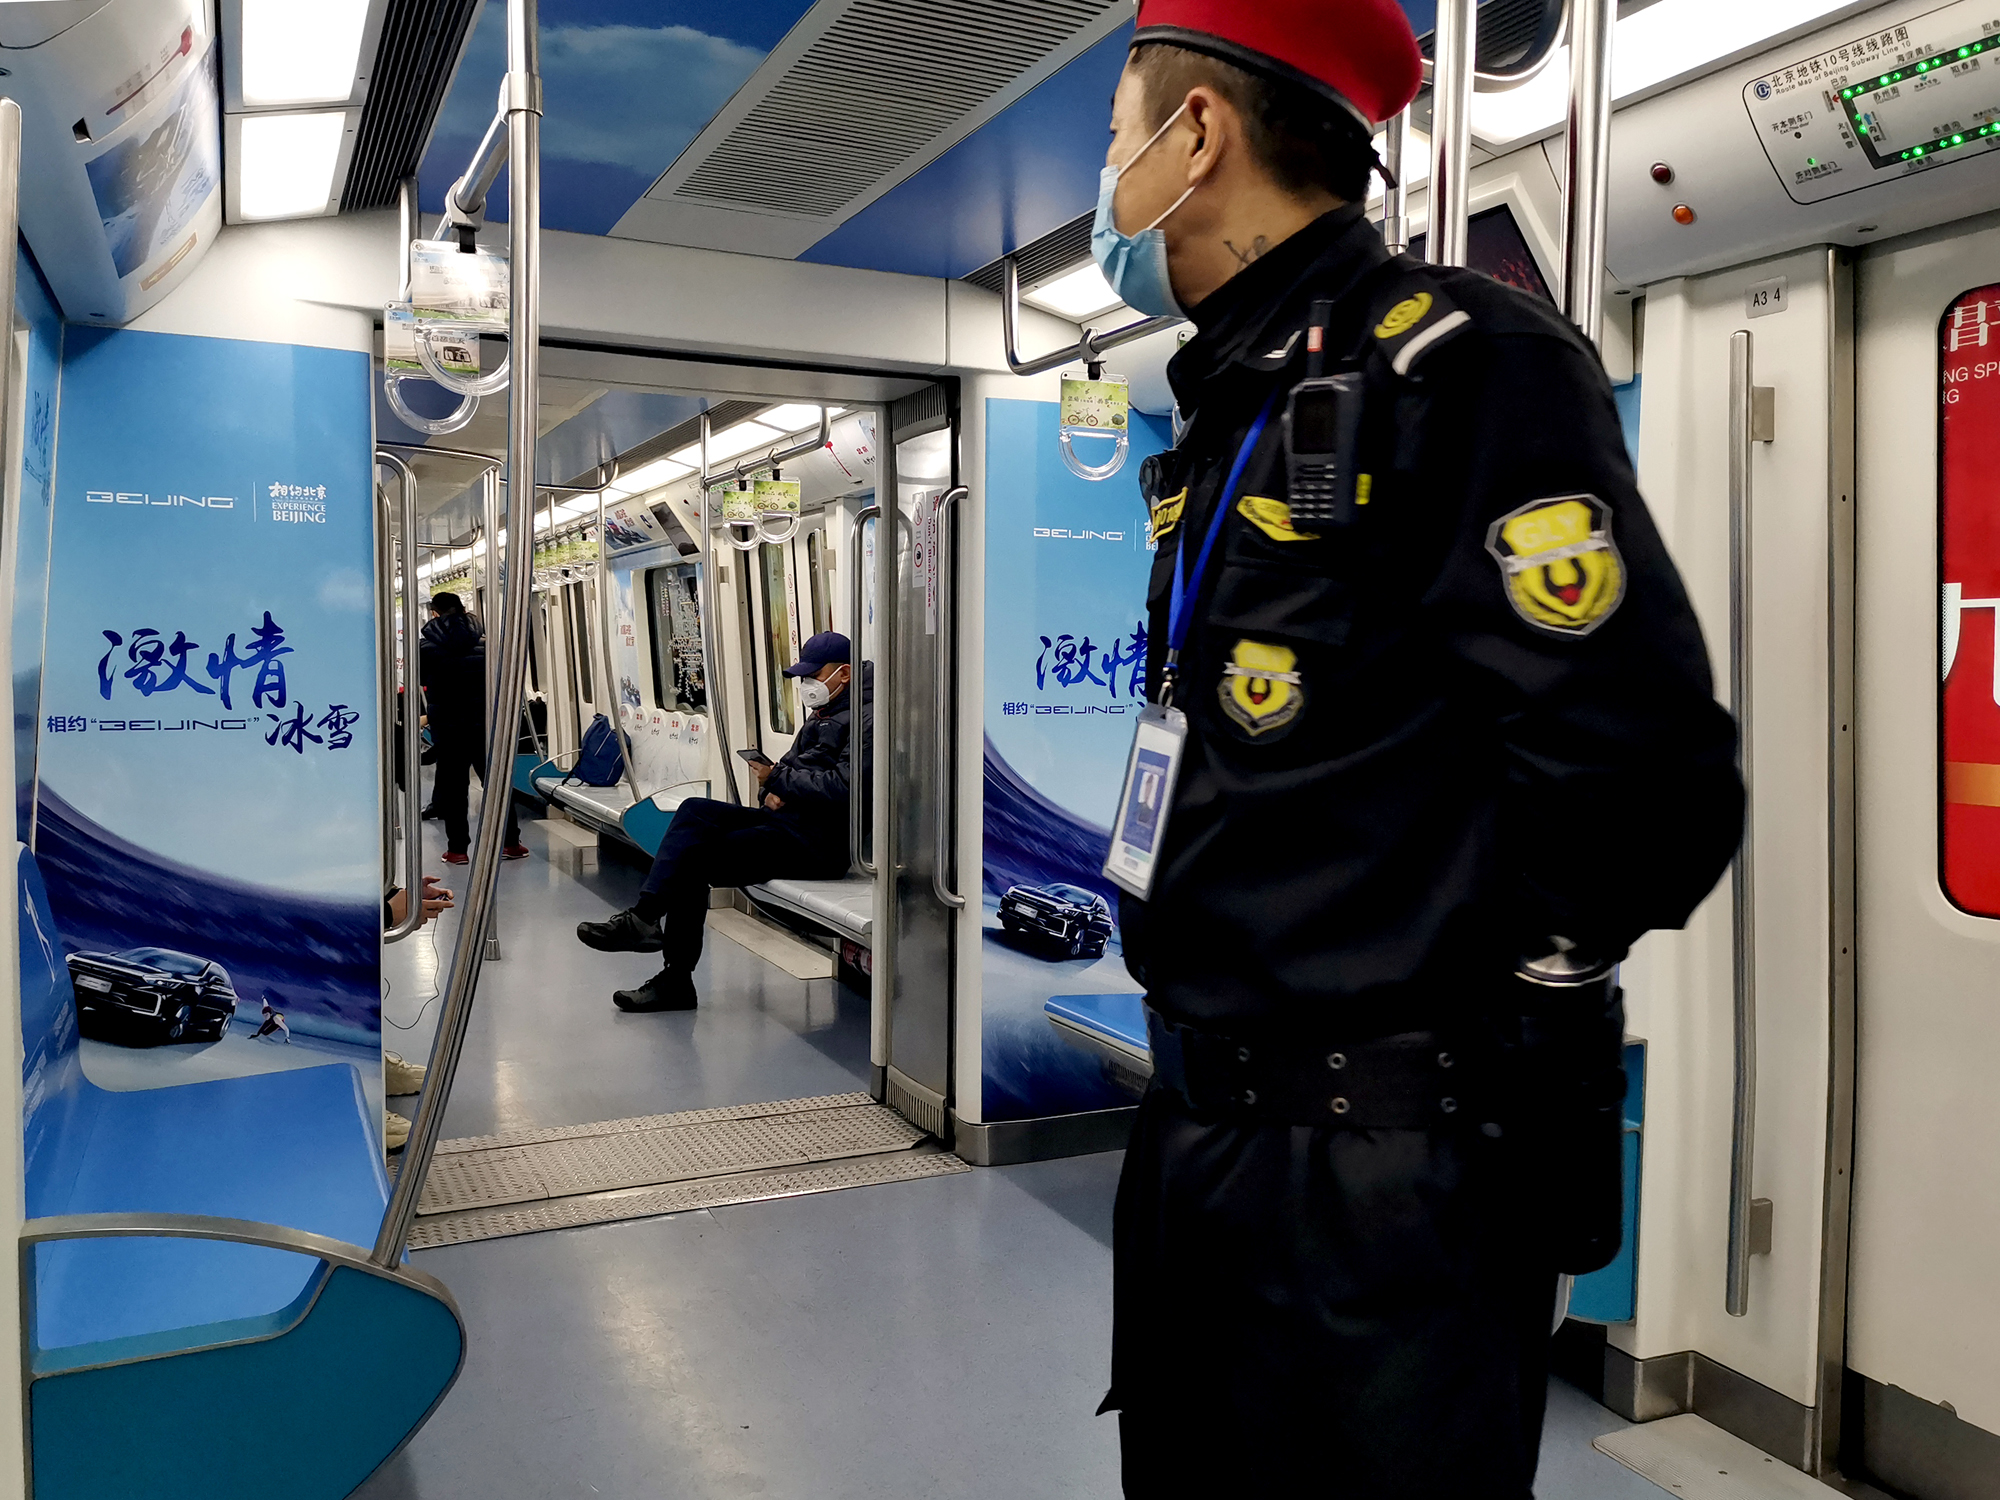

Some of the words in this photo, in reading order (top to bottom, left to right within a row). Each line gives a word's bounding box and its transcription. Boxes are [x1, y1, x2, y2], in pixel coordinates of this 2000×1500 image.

[1771, 26, 1909, 88] 北京地铁10号线线路图
[1775, 83, 1796, 96] Route
[1799, 77, 1813, 89] Map
[1815, 73, 1822, 82] of
[1823, 64, 1850, 79] Beijing
[1851, 53, 1880, 68] Subway
[1882, 44, 1899, 56] Line
[1902, 40, 1911, 49] 10
[1753, 291, 1767, 307] A3
[1774, 287, 1781, 302] 4
[86, 490, 235, 509] BEIJING
[268, 481, 327, 500] 相约北京
[271, 501, 327, 513] EXPERIENCE
[272, 510, 326, 524] BEIJING
[1033, 527, 1123, 541] BEIJING
[97, 610, 295, 710] 激情
[265, 701, 360, 754] 冰雪
